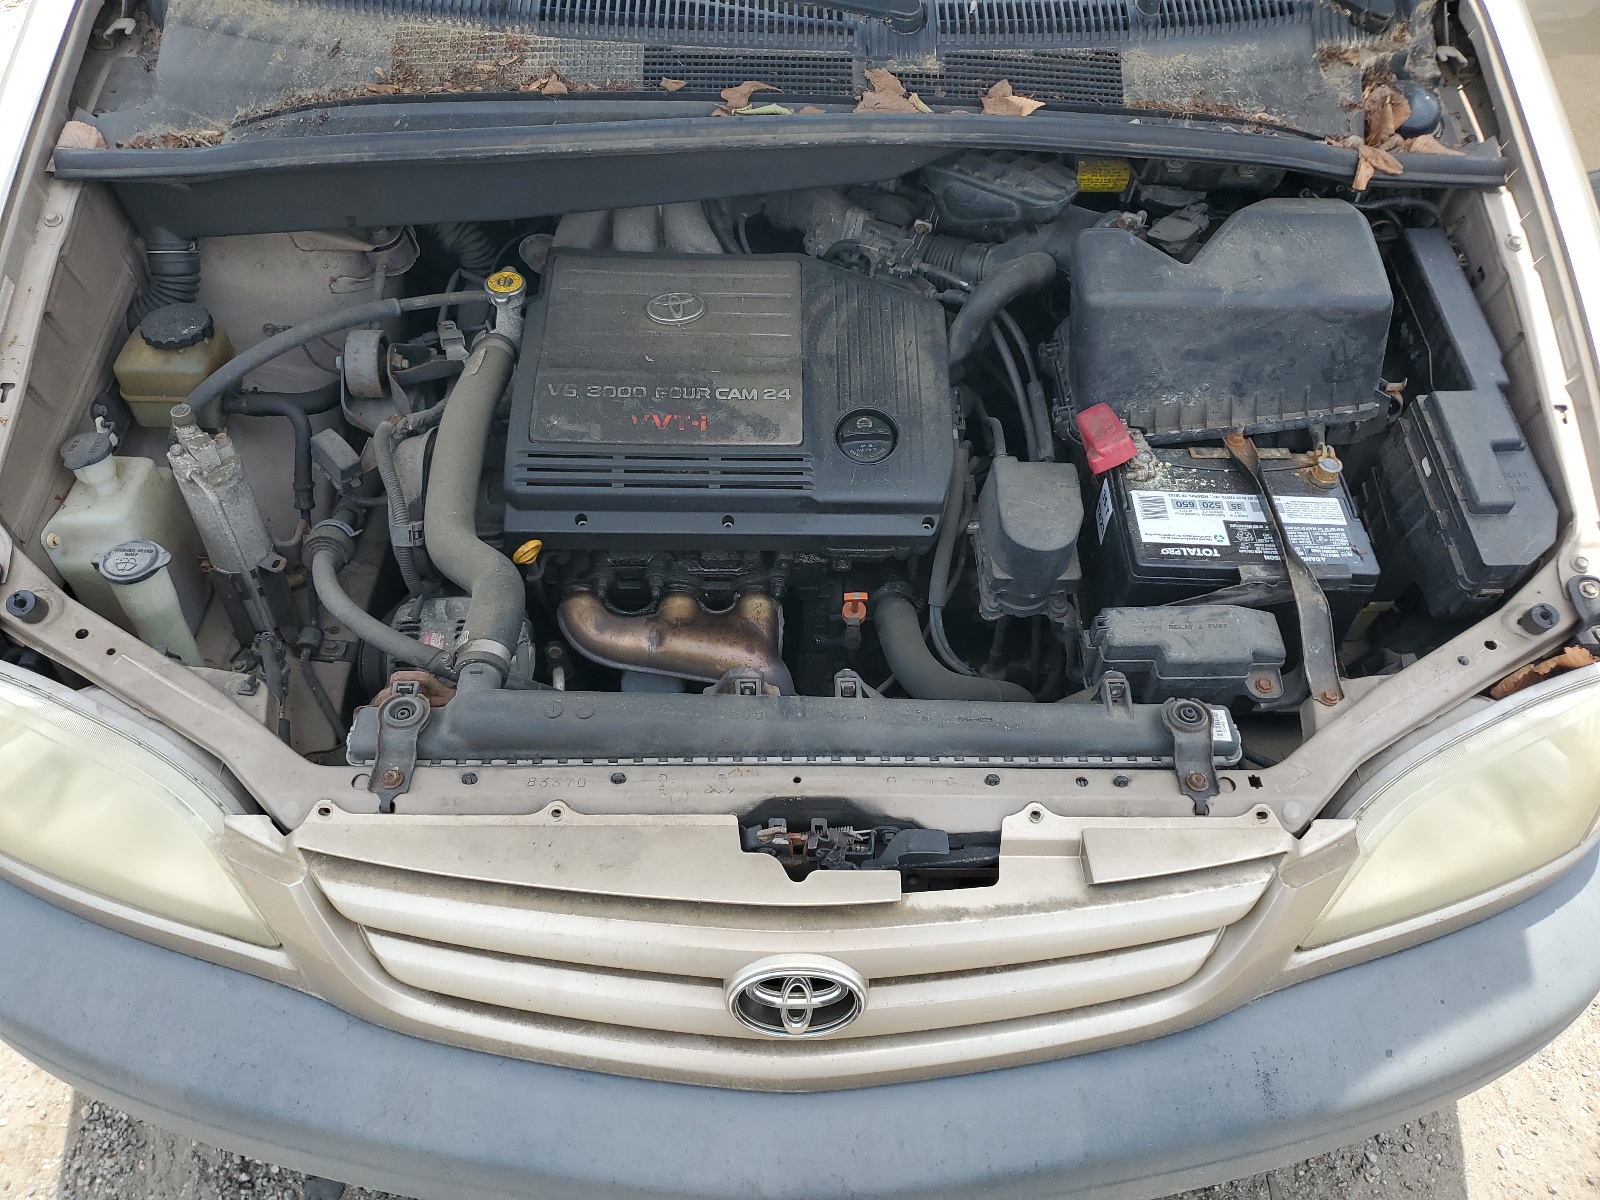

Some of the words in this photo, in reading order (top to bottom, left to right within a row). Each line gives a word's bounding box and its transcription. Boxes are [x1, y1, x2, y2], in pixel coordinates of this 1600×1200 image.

[586, 385, 647, 398] 3000
[655, 386, 711, 399] FOUR
[715, 388, 757, 400] CAM
[762, 388, 791, 400] 24
[631, 414, 707, 431] VVT-i
[1175, 500, 1195, 508] 650
[1202, 501, 1221, 509] 520
[1160, 547, 1221, 557] TOTALPRO
